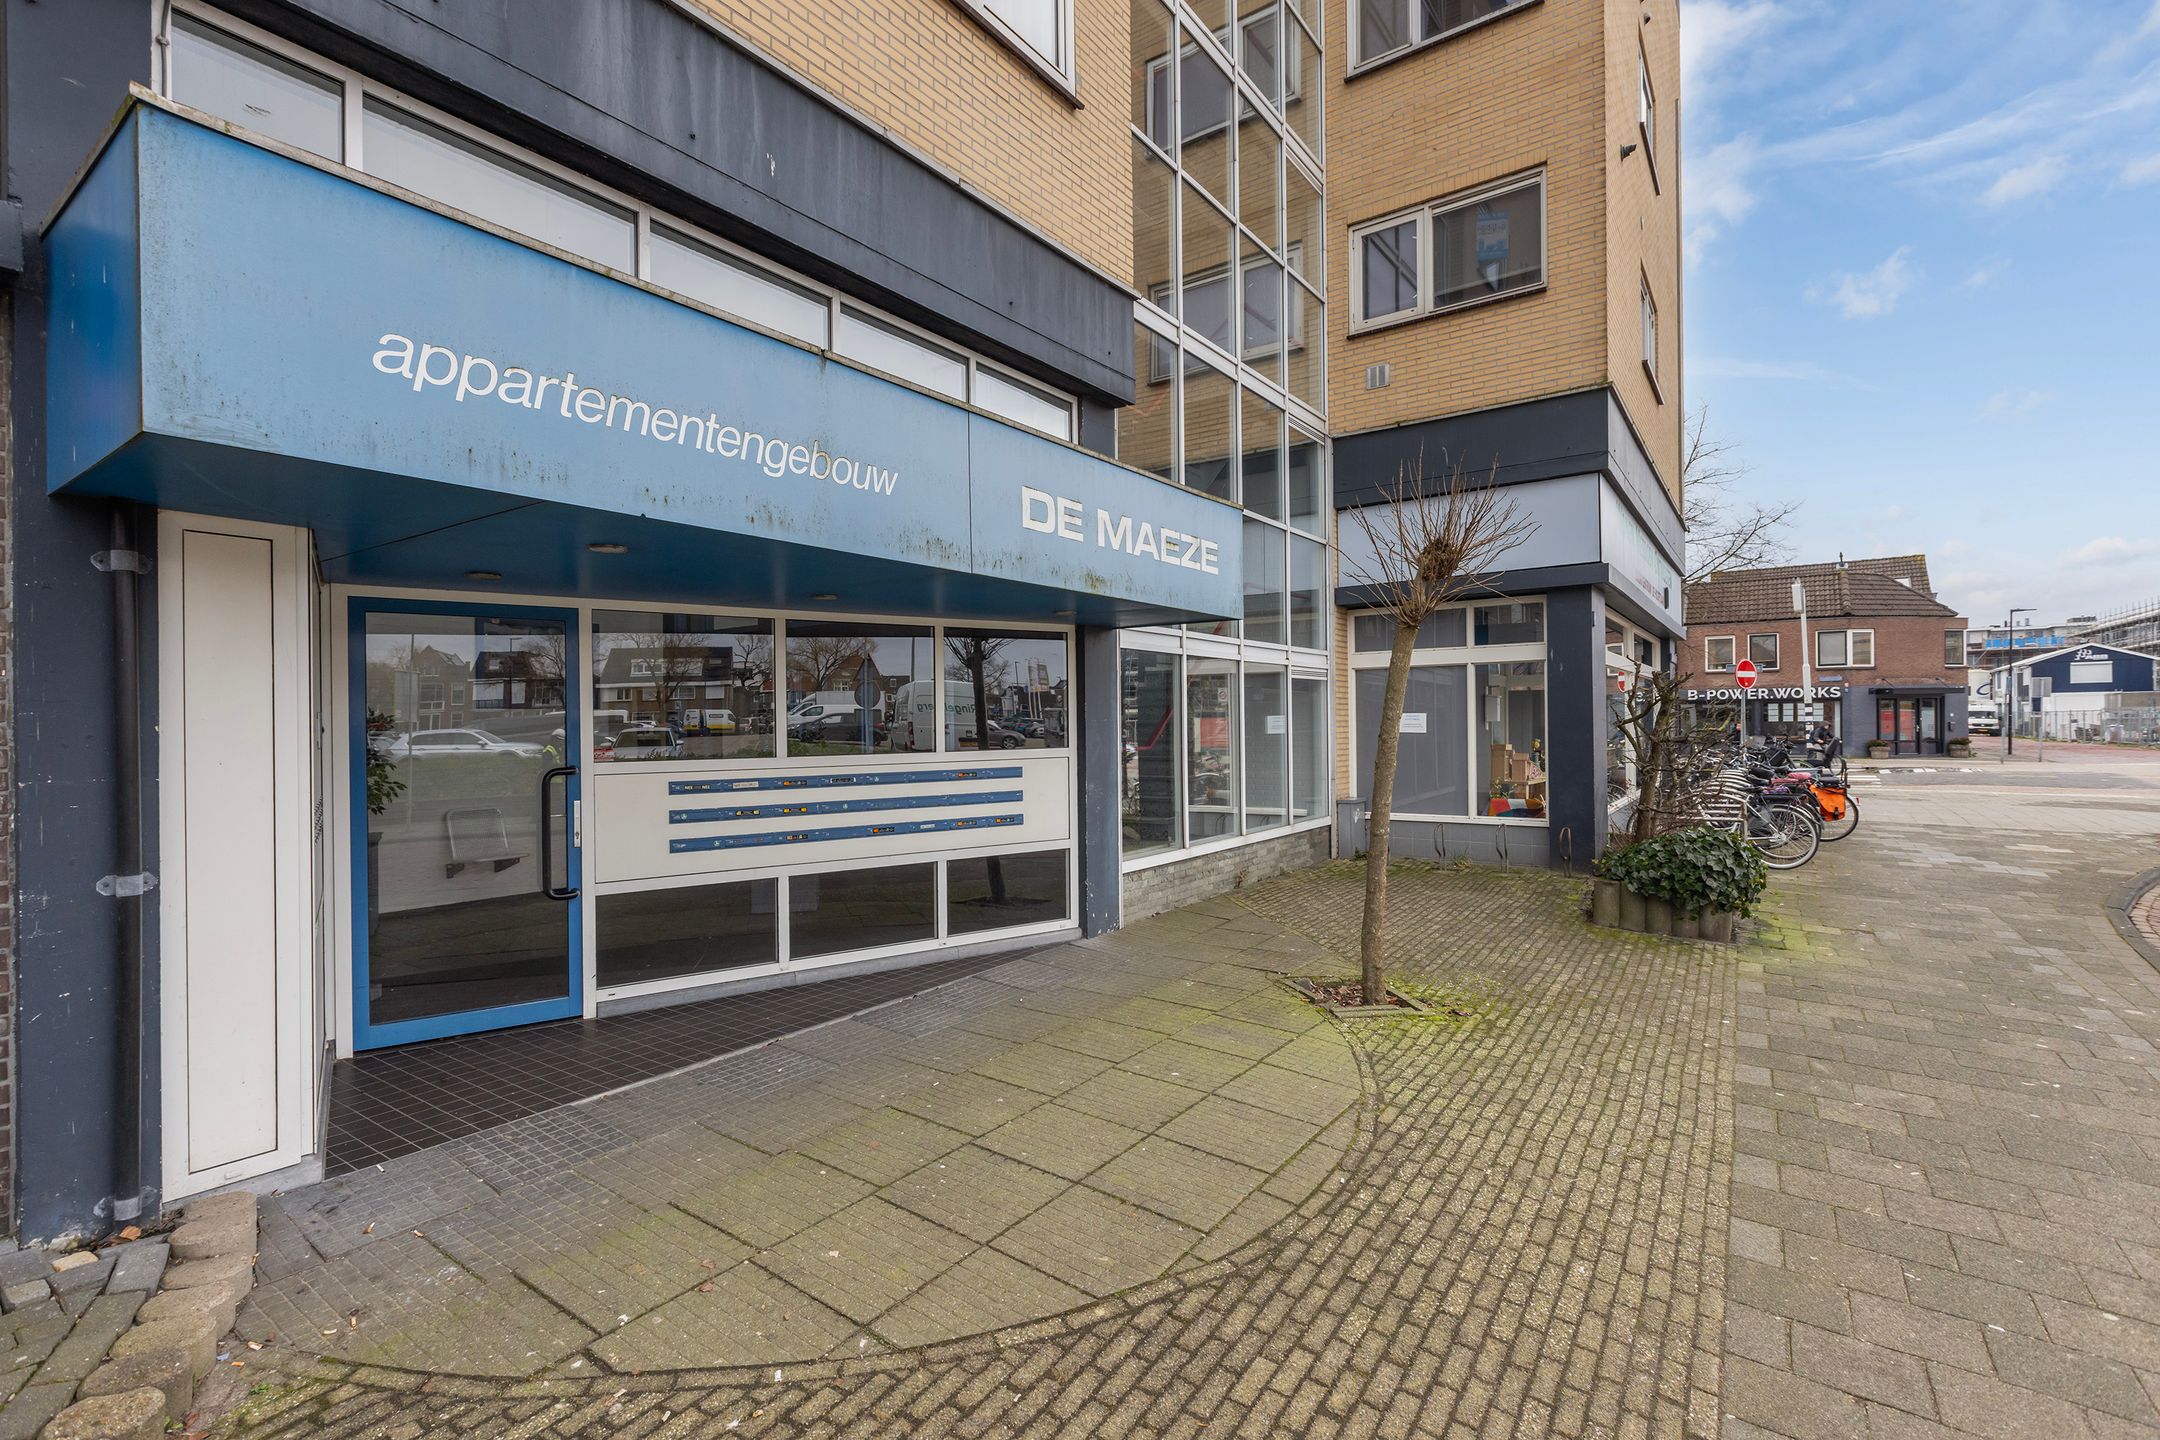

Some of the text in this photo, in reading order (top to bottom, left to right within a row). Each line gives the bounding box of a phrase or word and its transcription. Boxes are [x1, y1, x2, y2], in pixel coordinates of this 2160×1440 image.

[372, 334, 899, 497] appartementengebouw
[1021, 486, 1219, 576] DE MAEZE
